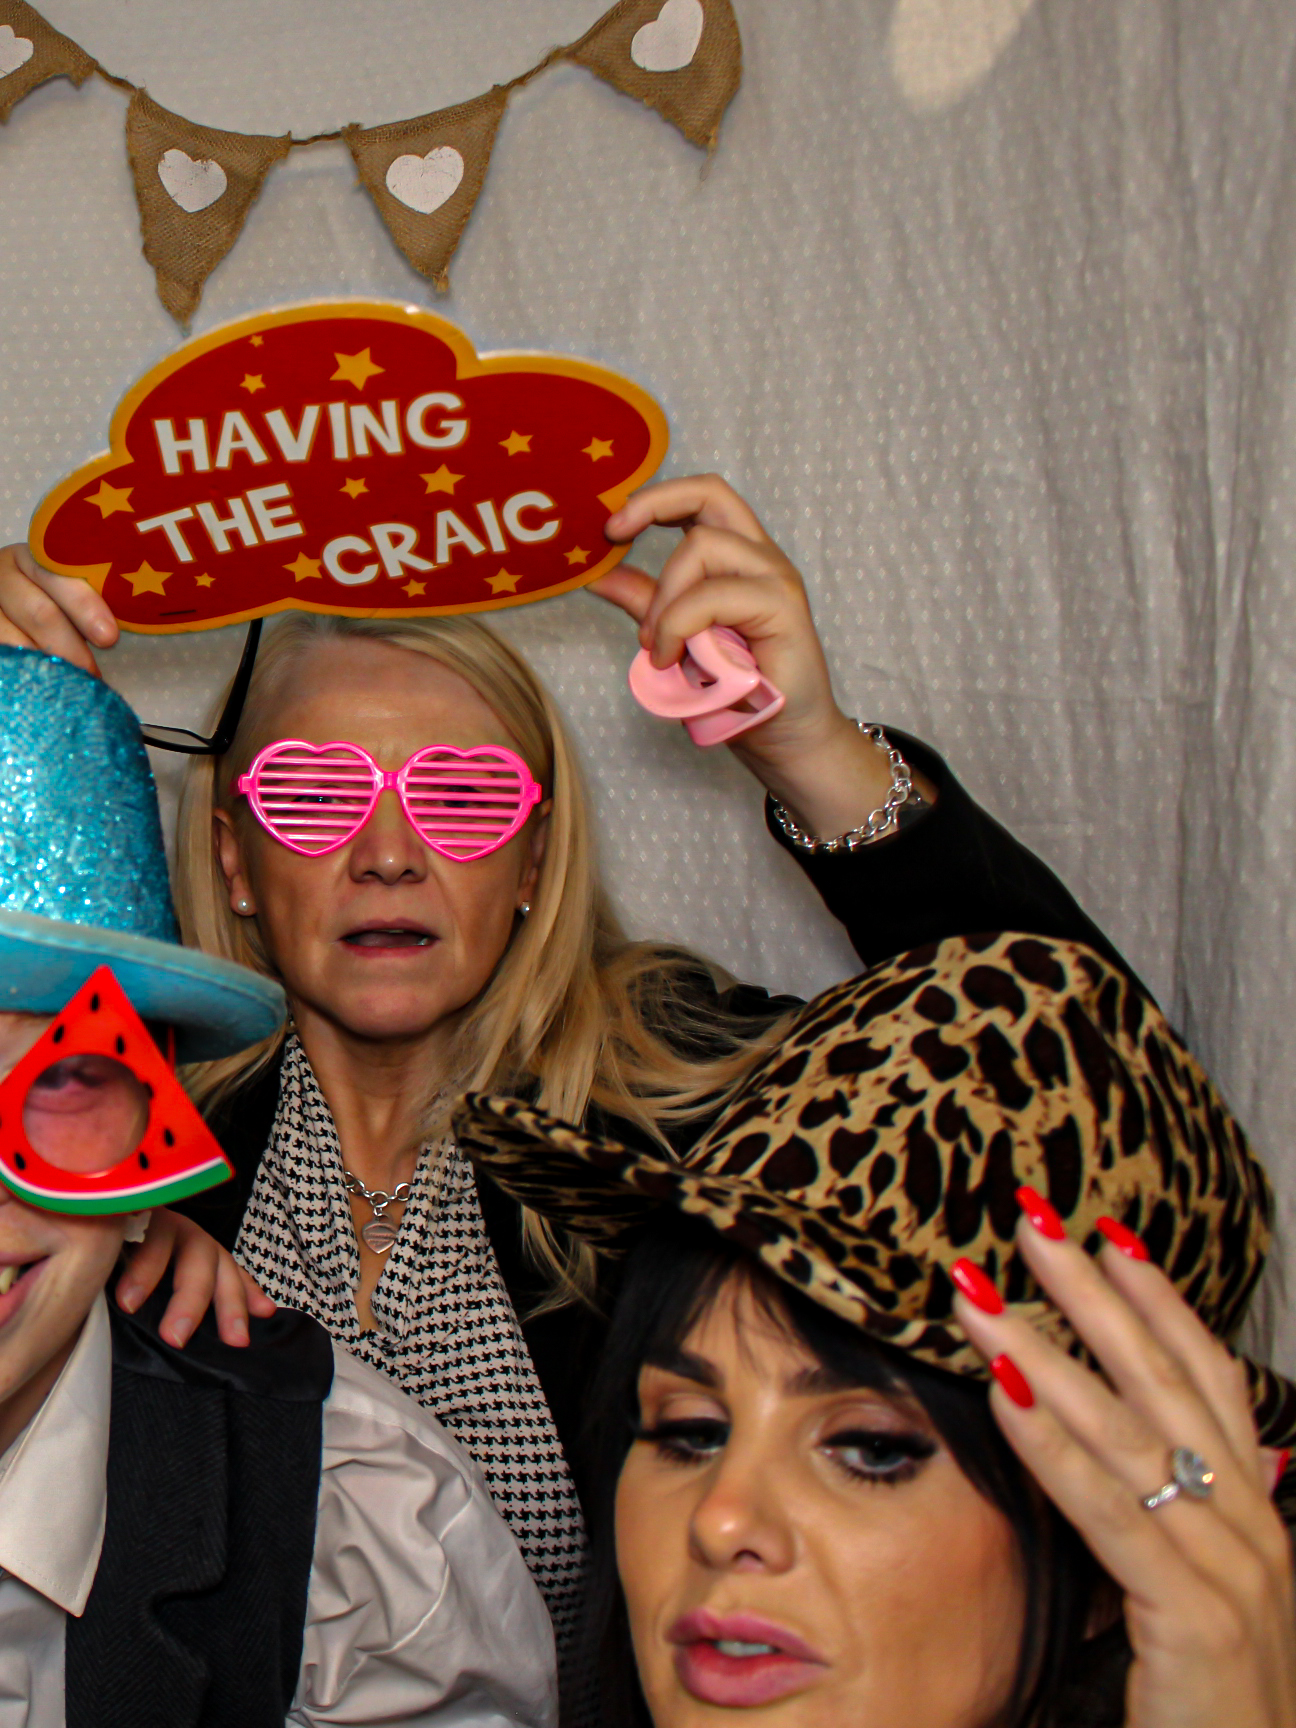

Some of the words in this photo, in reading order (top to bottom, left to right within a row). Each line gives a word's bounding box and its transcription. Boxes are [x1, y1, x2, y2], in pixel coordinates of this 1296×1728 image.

[153, 391, 469, 475] HAVING
[136, 483, 304, 563] THE
[321, 490, 561, 586] CRAIC
